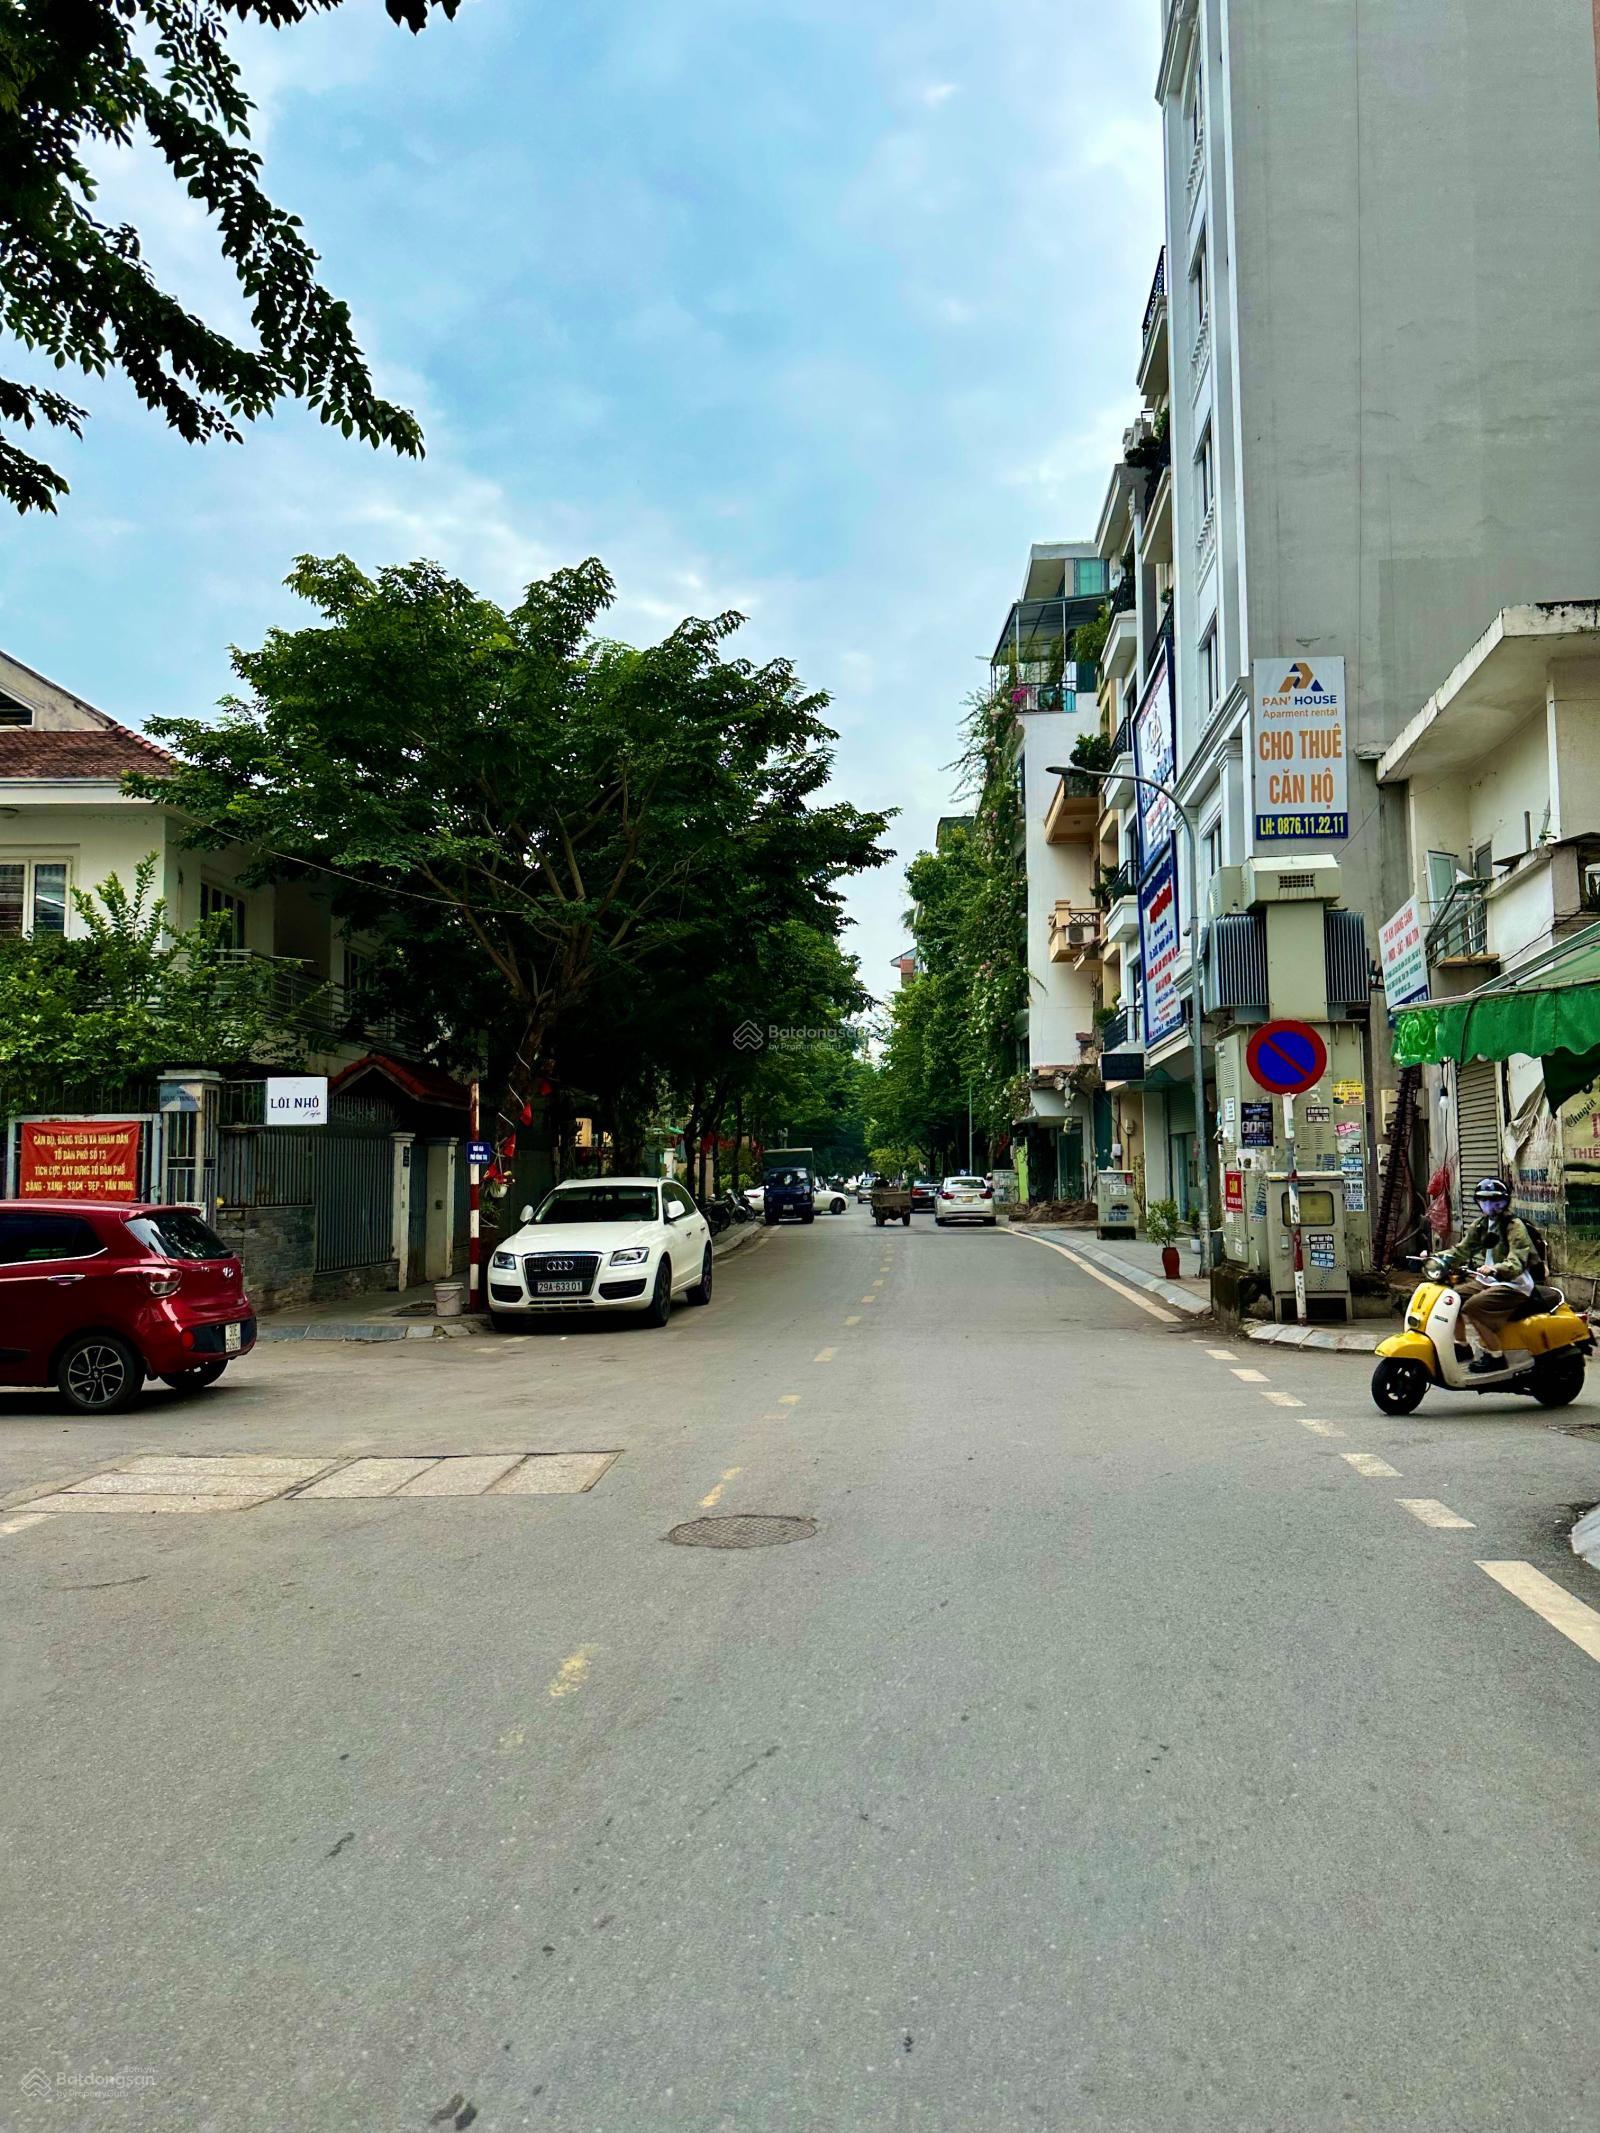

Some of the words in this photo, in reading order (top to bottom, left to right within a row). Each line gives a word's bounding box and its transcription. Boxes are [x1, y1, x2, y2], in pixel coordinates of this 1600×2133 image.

[1294, 695, 1337, 705] HOUSE
[1263, 709, 1308, 720] Aparment
[1311, 708, 1337, 716] rental
[1260, 730, 1293, 760] CHO
[1299, 723, 1342, 759] THUÊ
[1269, 768, 1305, 804] CĂN
[1310, 767, 1334, 809] HỘ
[1260, 817, 1275, 835] LH:
[1277, 816, 1344, 834] 0876.11.22.11
[294, 1095, 319, 1109] NHỎ
[63, 1148, 75, 1159] DÂN
[89, 1147, 98, 1159] SỐ
[100, 1163, 112, 1175] DÂN
